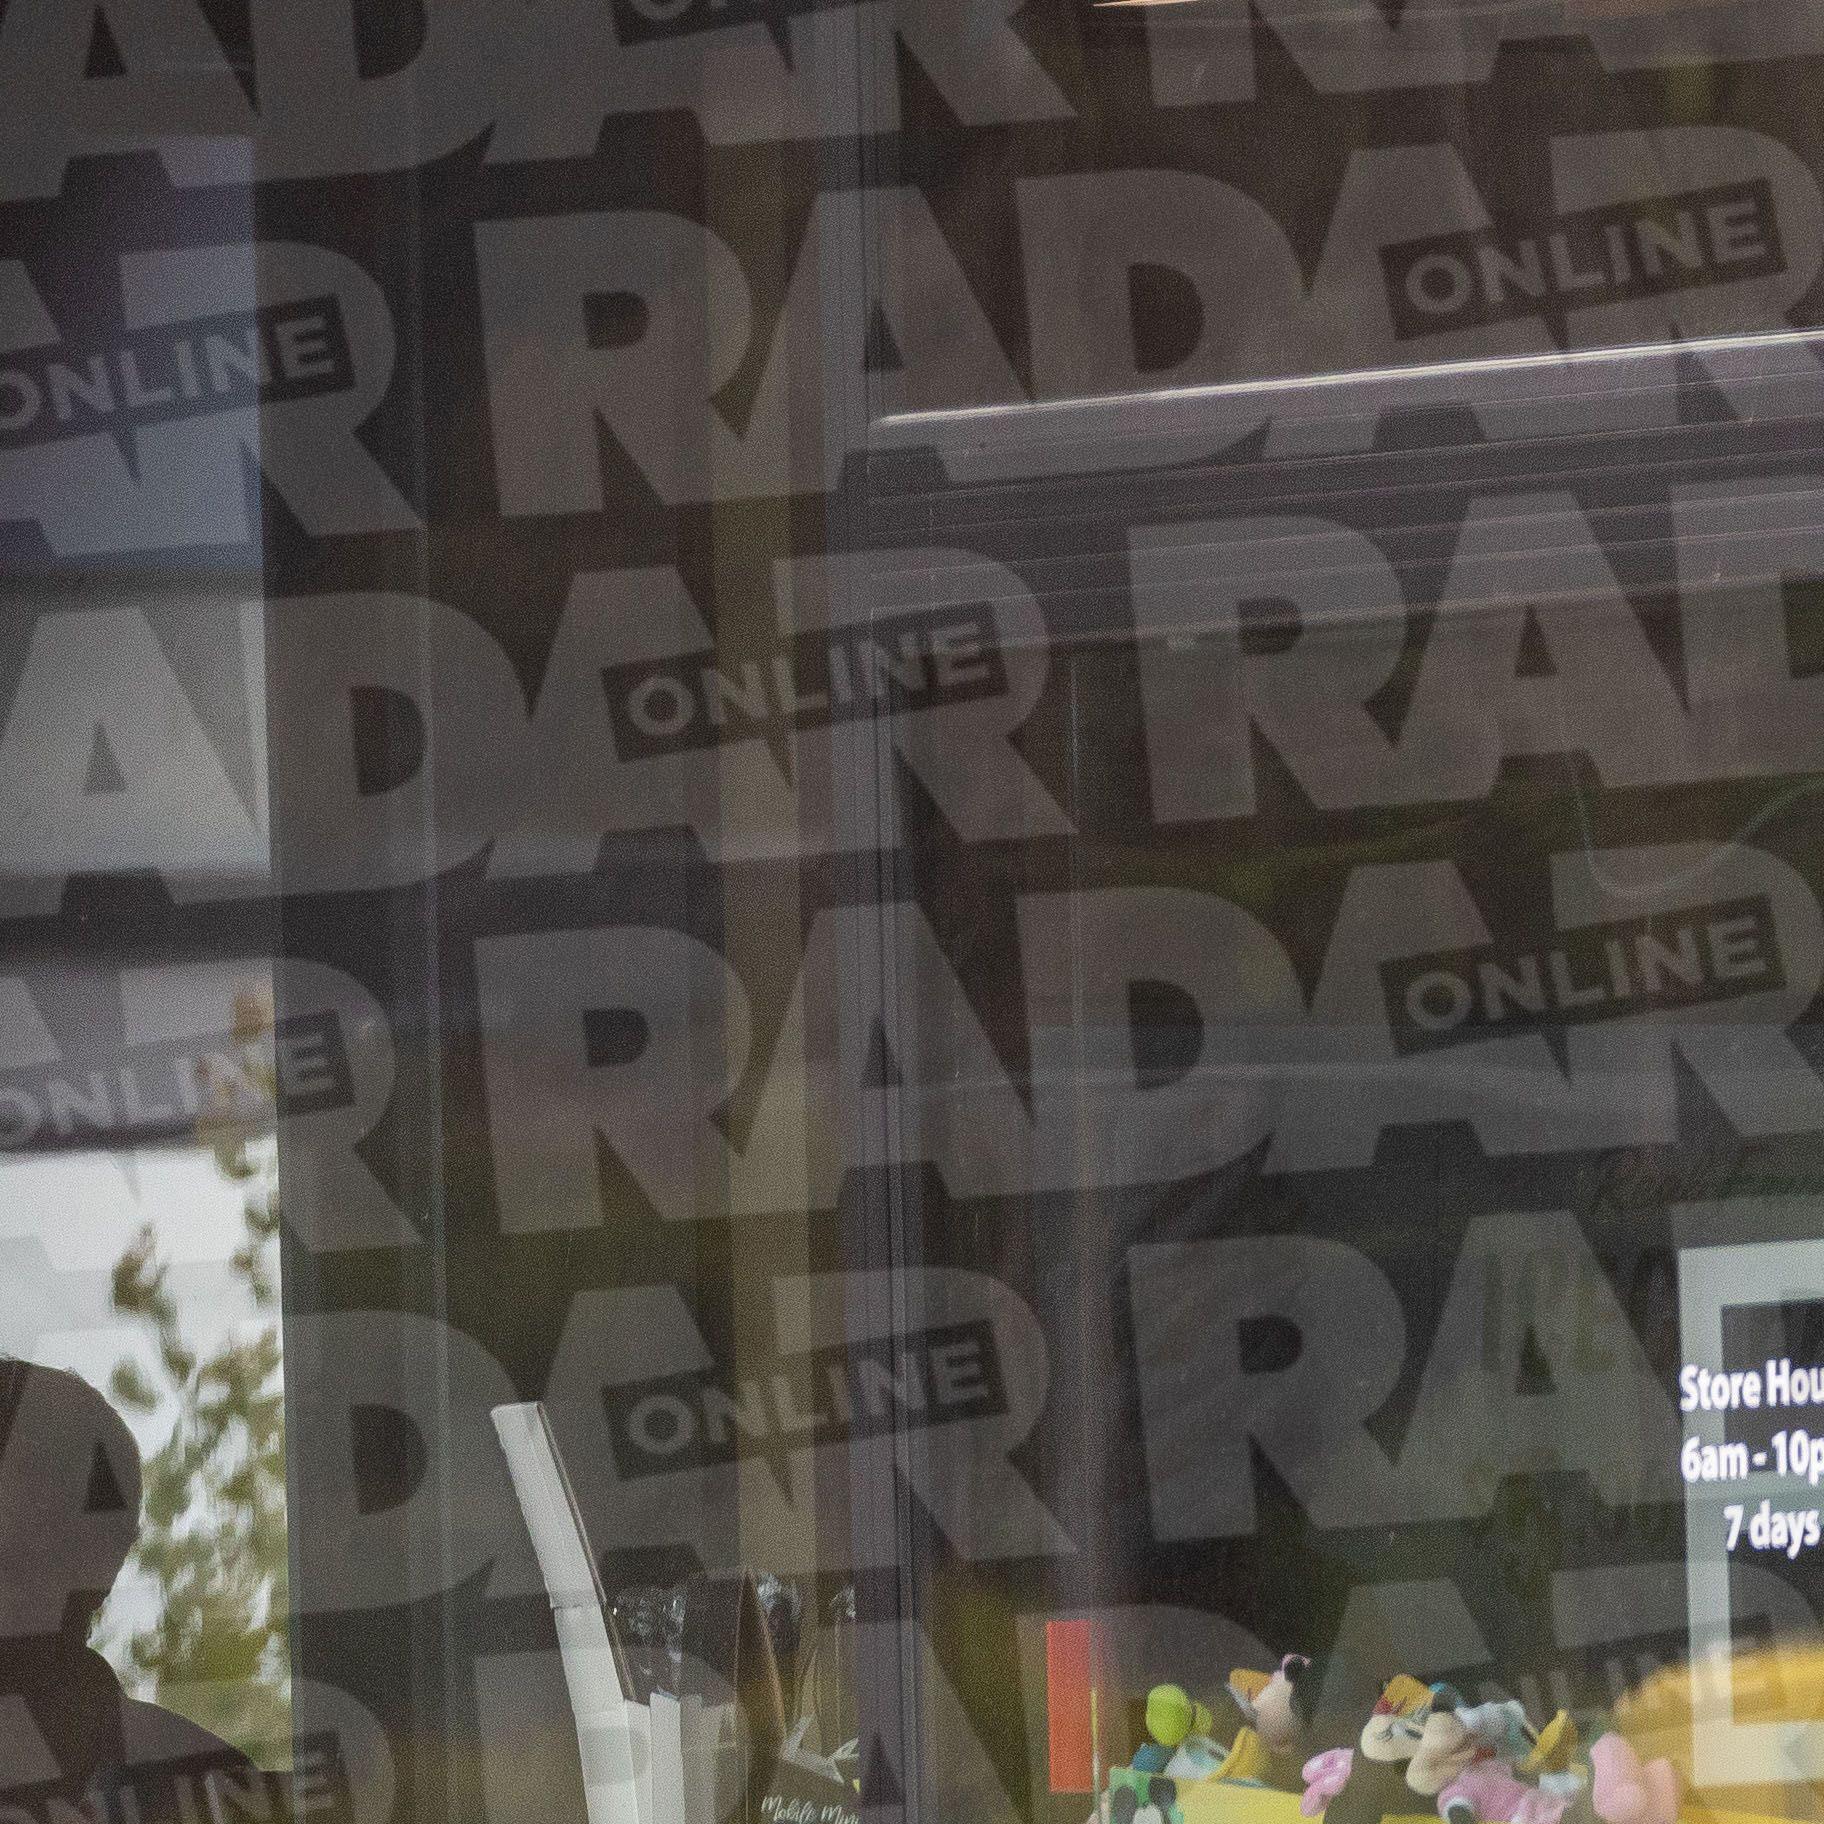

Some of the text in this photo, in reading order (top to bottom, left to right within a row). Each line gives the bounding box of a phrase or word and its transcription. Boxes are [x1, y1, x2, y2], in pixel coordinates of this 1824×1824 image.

[1680, 1364, 1762, 1412] Store
[1680, 1436, 1749, 1483] 6am
[1723, 1500, 1821, 1560] 7 days
